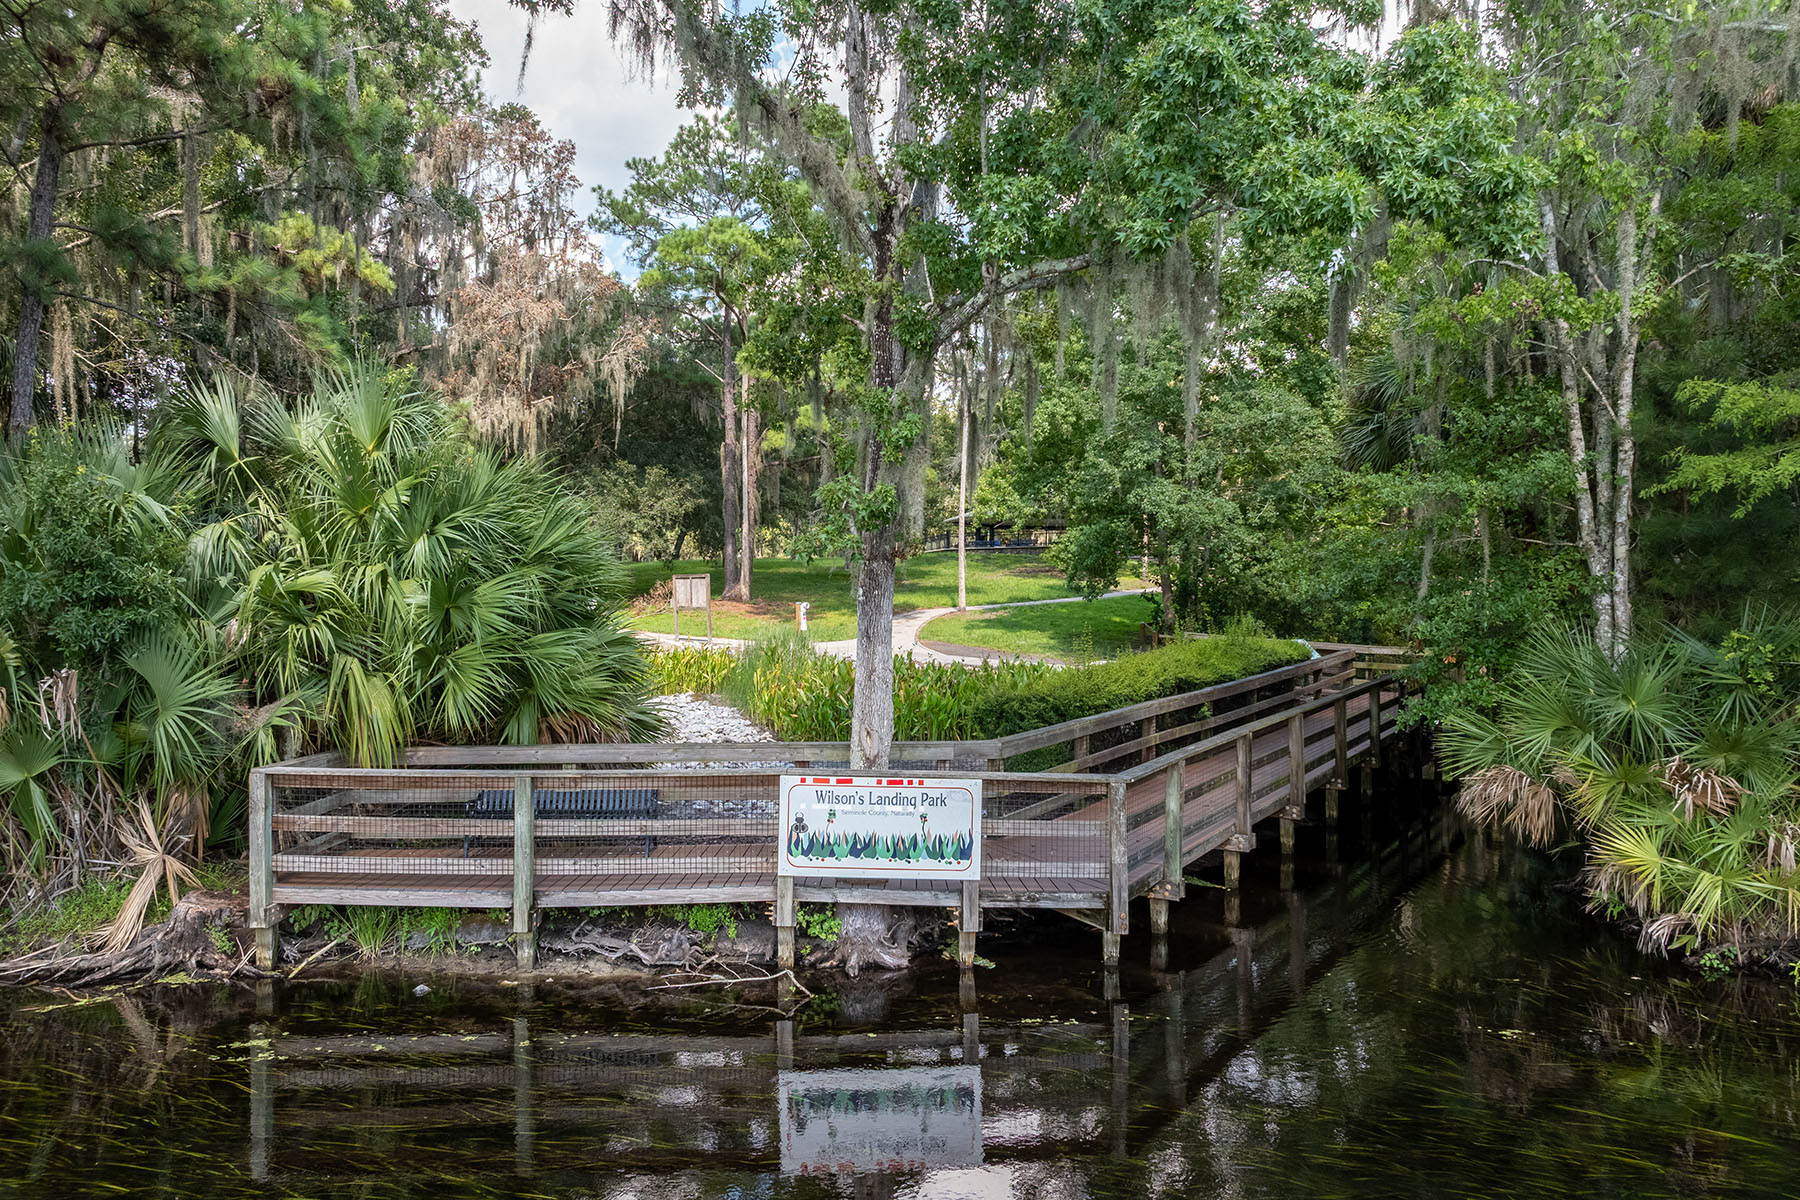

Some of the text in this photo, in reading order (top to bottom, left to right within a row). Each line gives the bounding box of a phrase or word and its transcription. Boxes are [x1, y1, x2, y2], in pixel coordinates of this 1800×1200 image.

[815, 790, 947, 810] Wilson's Landing Park
